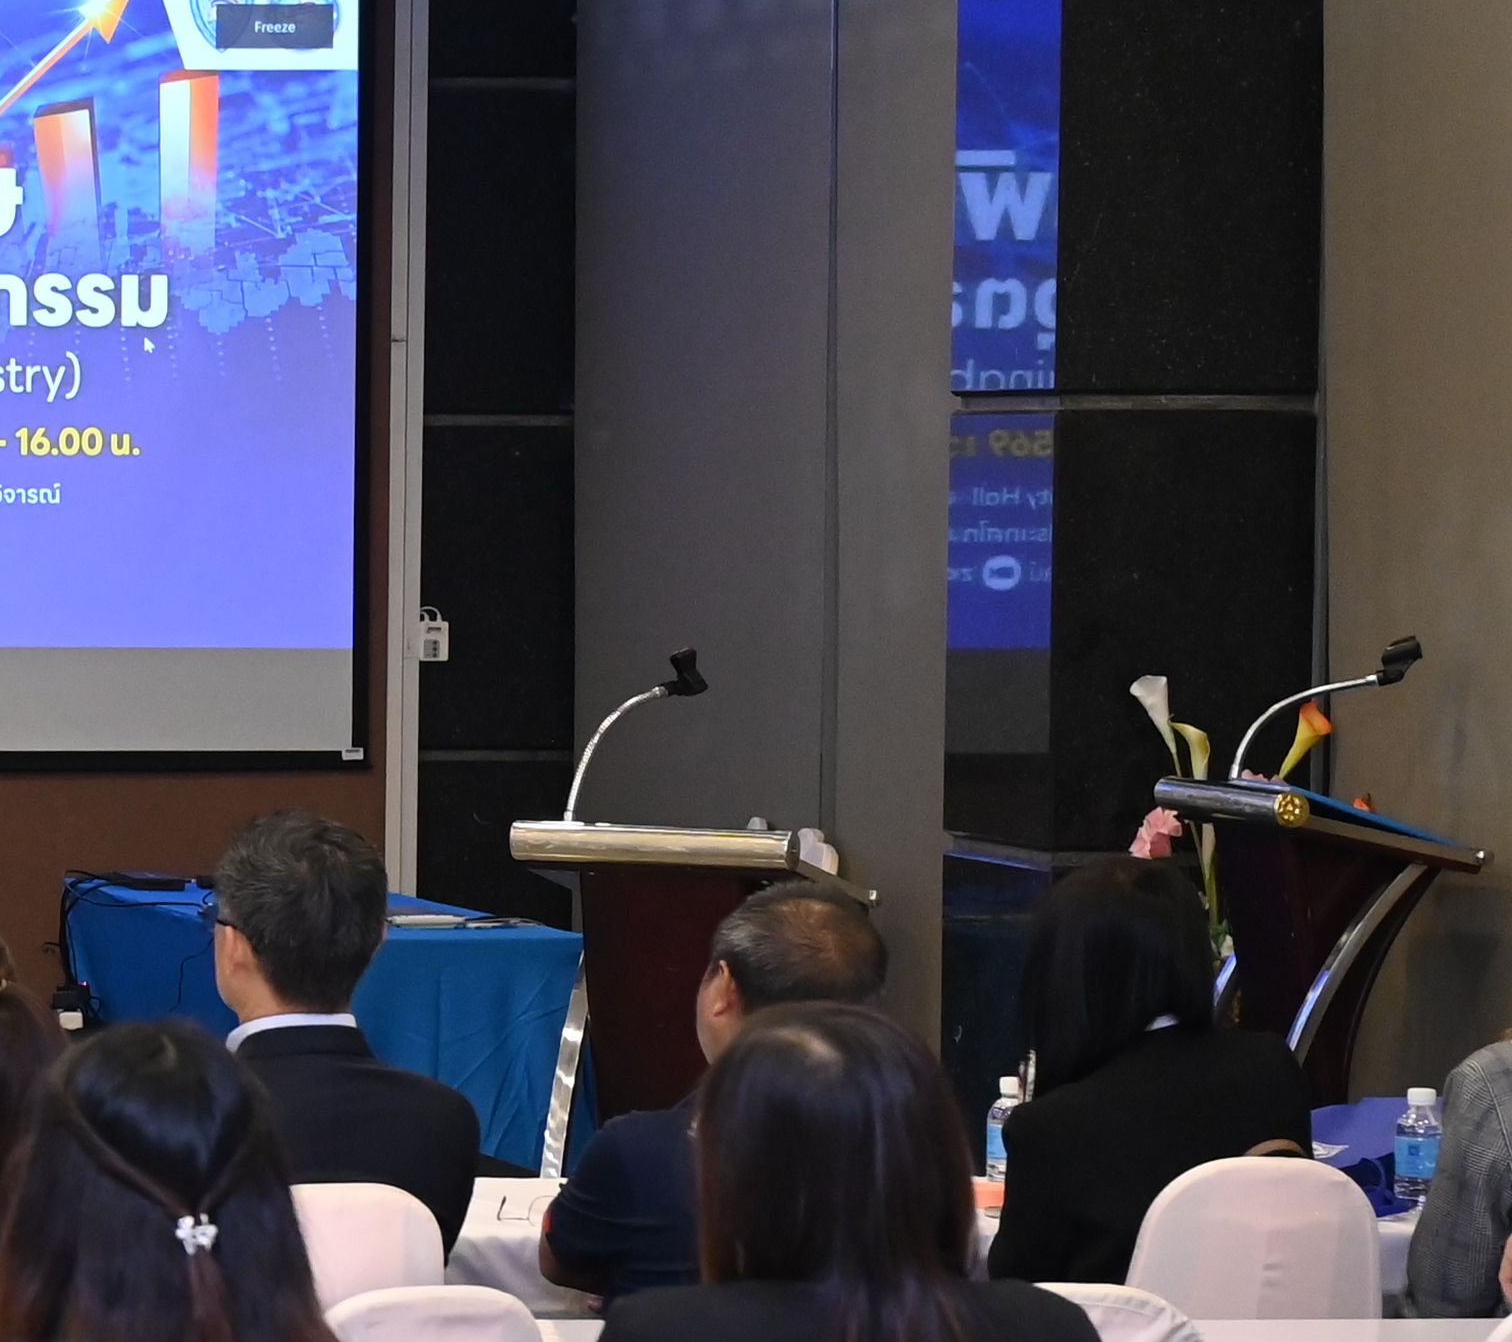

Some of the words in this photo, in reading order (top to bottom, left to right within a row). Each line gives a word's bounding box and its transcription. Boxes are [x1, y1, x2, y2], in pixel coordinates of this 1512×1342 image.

[254, 20, 296, 34] Freeze
[15, 426, 104, 456] 16.00
[111, 432, 142, 457] น.
